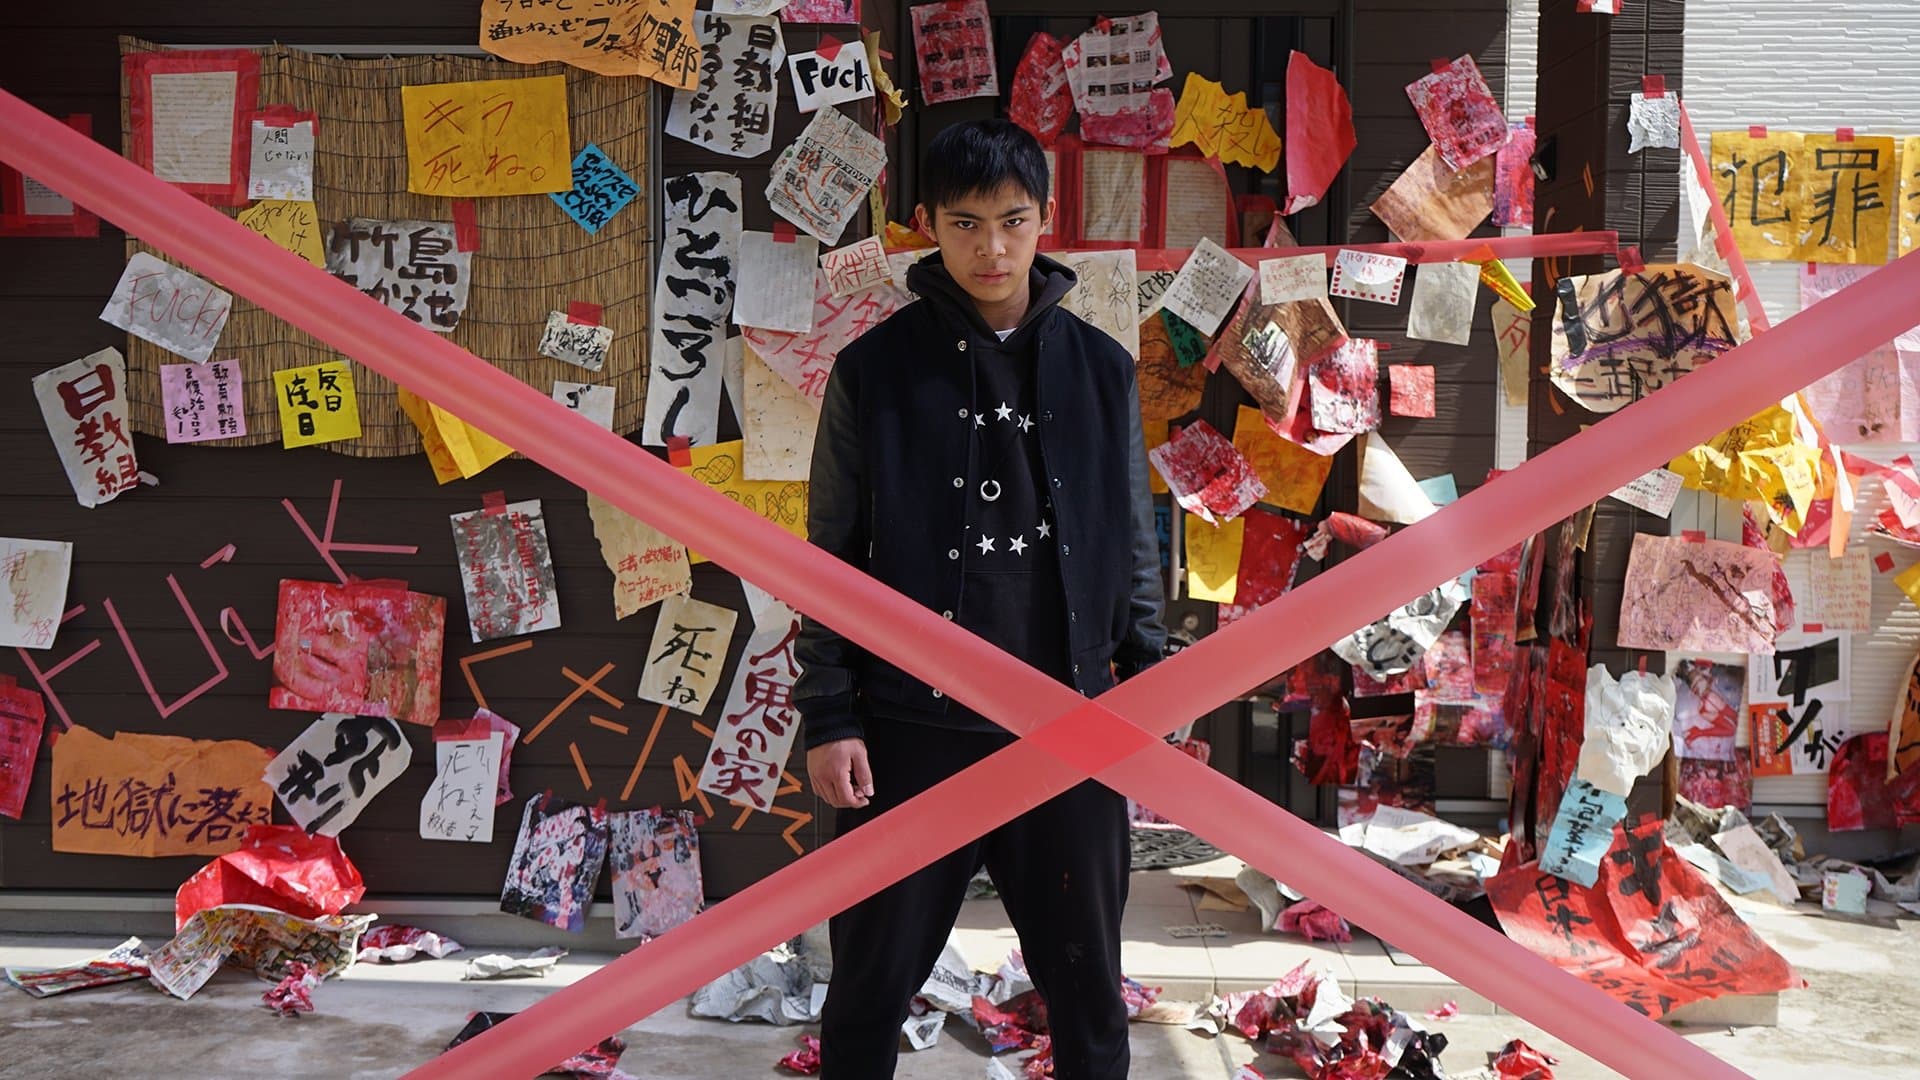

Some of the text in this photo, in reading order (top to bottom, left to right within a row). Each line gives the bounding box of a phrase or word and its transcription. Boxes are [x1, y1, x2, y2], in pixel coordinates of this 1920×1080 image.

[263, 128, 289, 145] 人間
[424, 92, 514, 136] キラ
[264, 150, 309, 162] じゃない
[1722, 148, 1920, 250] 犯罪
[287, 204, 312, 262] 化け
[332, 226, 458, 285] 竹島
[660, 174, 738, 447] ひとごろし
[317, 368, 343, 413] 反日
[57, 364, 142, 497] 日教組
[652, 621, 717, 705] 死ね
[708, 593, 803, 808] 人鬼の家
[437, 743, 472, 812] 死ね
